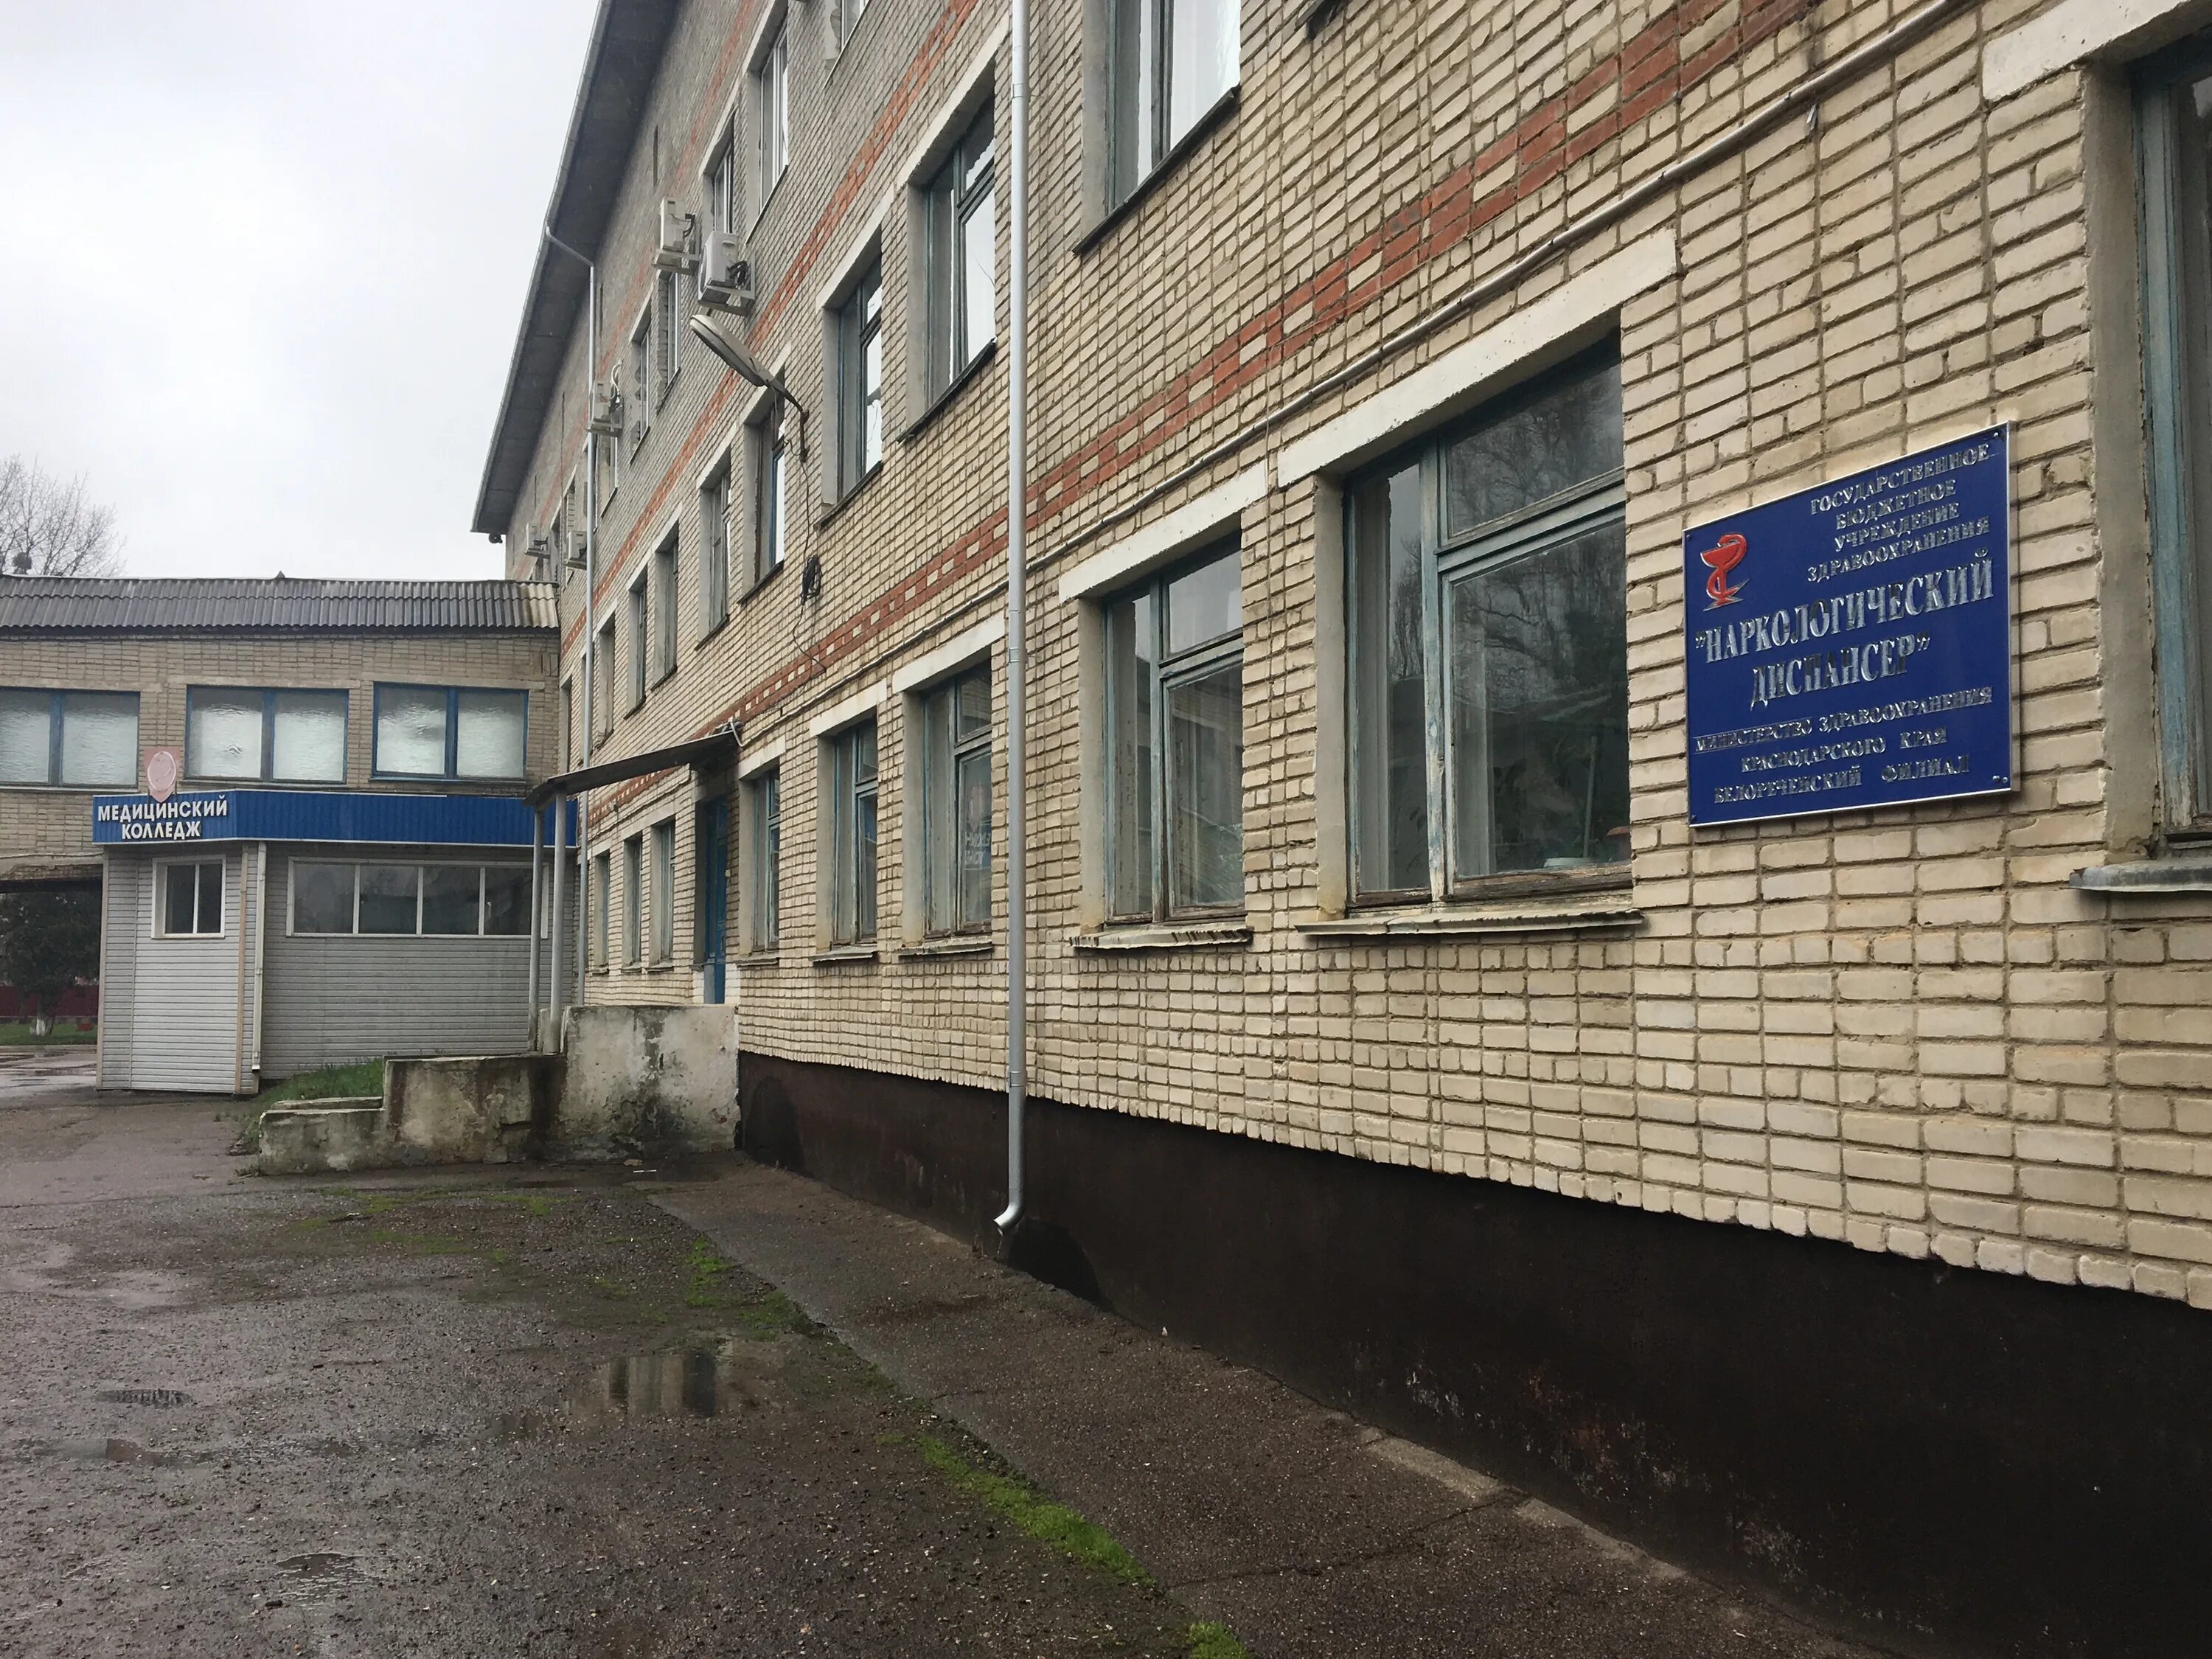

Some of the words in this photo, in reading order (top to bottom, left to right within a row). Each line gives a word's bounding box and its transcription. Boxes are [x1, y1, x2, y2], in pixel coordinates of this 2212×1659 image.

[1811, 444, 1989, 515] ГОСУДАРСТВЕННОЕ
[1836, 479, 1956, 530] БЮДЖЕТНОЕ
[1807, 516, 1989, 582] ЗДРАВООХРАНЕНИЯ
[1834, 503, 1959, 552] УЧРЕЖДЕНИЕ
[1695, 719, 1812, 753] МИНИСТЕРСТВО
[1818, 686, 1992, 733] ЗДРАВООХРАНЕНИЯ
[1742, 737, 1886, 772] КРАСНОДАРСКОГО
[1899, 726, 1947, 749] КРАЯ
[1714, 765, 1862, 804] БЕЛОРЕЧЕНСКИЙ
[1882, 754, 1969, 783] ФИЛИАЛ
[97, 794, 227, 822] МЕДИЦИНСКИЙ
[122, 821, 201, 840] КОЛЛЕДЖ
